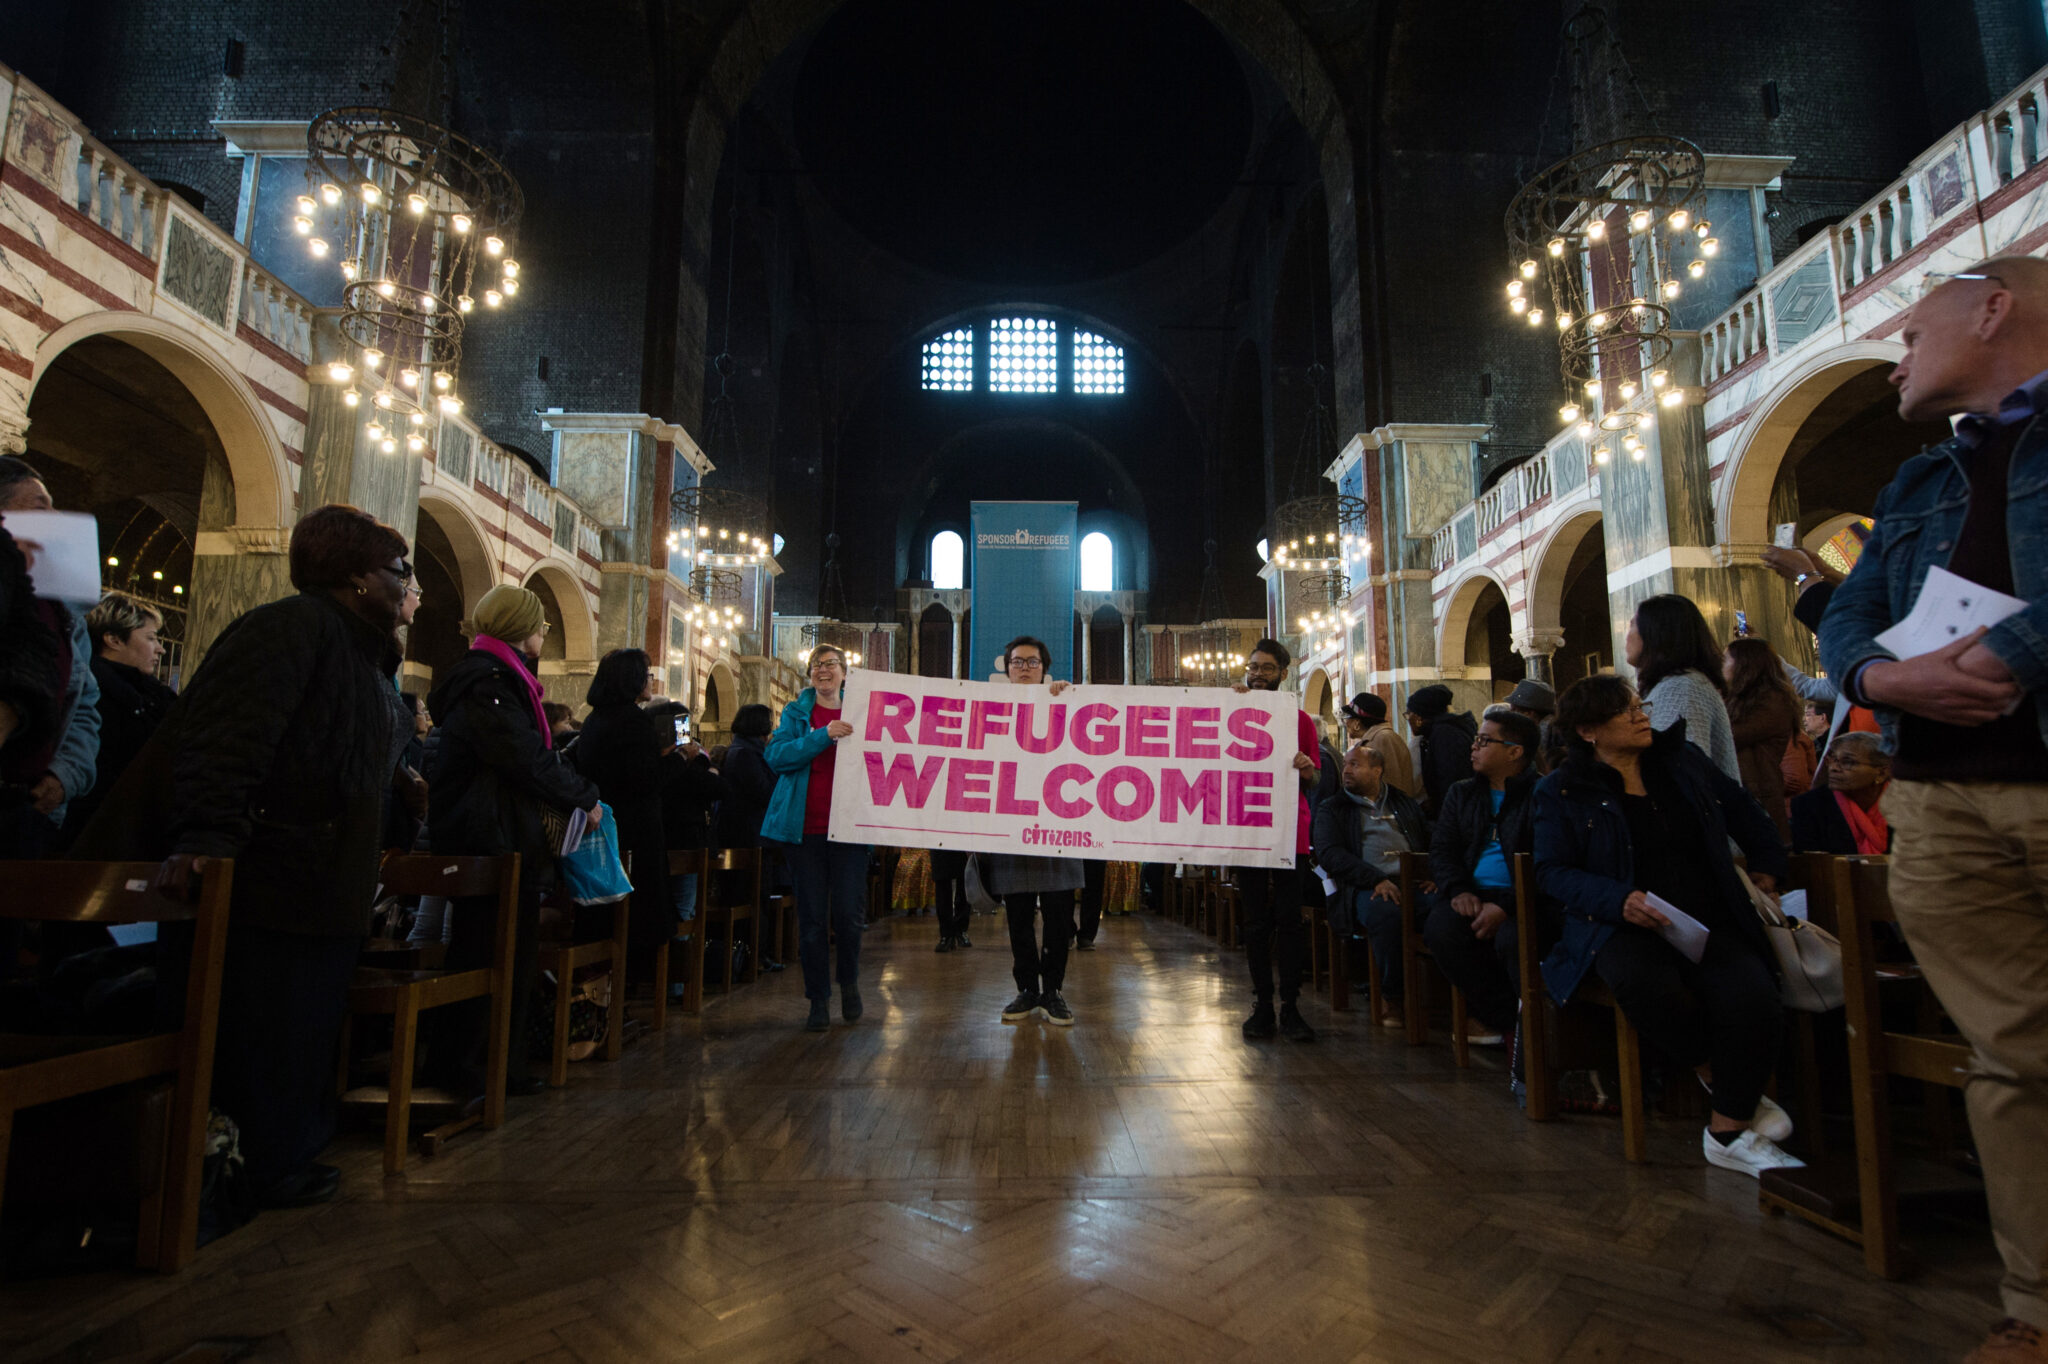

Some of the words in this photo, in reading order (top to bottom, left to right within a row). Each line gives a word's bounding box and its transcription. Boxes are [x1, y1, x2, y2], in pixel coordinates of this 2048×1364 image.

[977, 534, 1015, 544] SPONSOR
[1029, 534, 1069, 544] REFUGEES
[865, 690, 1275, 762] REFUGEES
[863, 751, 1274, 828] WELCOME
